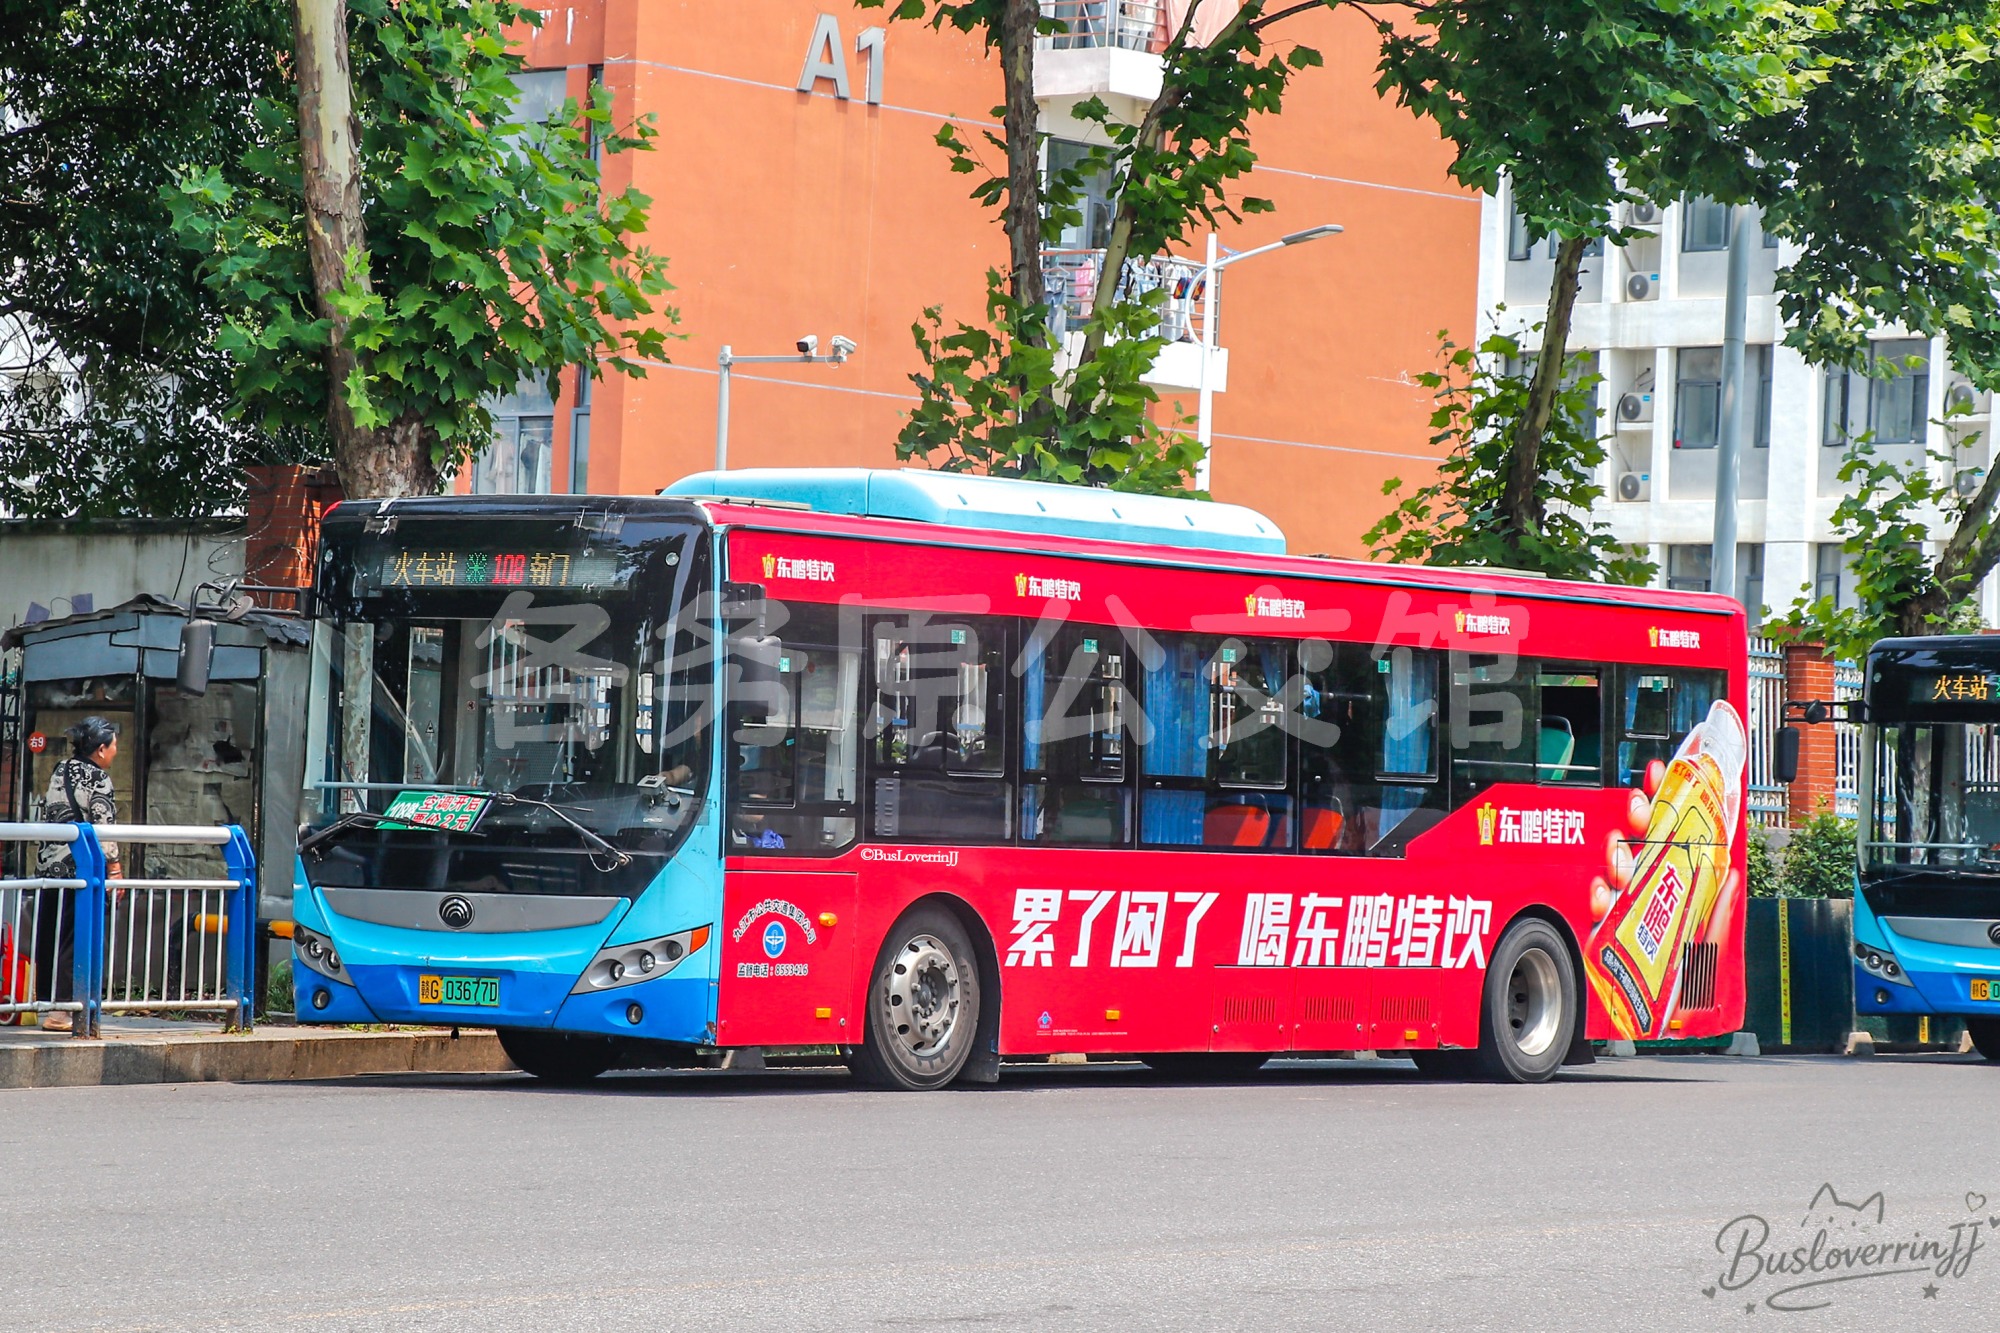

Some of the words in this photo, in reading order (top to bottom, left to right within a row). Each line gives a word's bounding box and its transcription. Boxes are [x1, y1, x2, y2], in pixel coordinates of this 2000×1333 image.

[797, 13, 886, 104] A1
[391, 552, 458, 586] 火车站
[492, 554, 527, 584] 108
[777, 557, 835, 582] 东鹏特饮
[1028, 576, 1081, 601] 东鹏特饮
[1257, 596, 1305, 619] 东鹏特饮
[1466, 613, 1511, 635] 东鹏特饮
[1659, 627, 1701, 649] 东鹏特饮
[1932, 675, 1990, 700] 火车站
[420, 795, 482, 811] 空调开启
[1499, 807, 1585, 845] 东鹏特饮
[1643, 863, 1685, 946] 东鹏
[1004, 888, 1220, 968] 累了困了
[1237, 892, 1493, 969] 喝东鹏特饮
